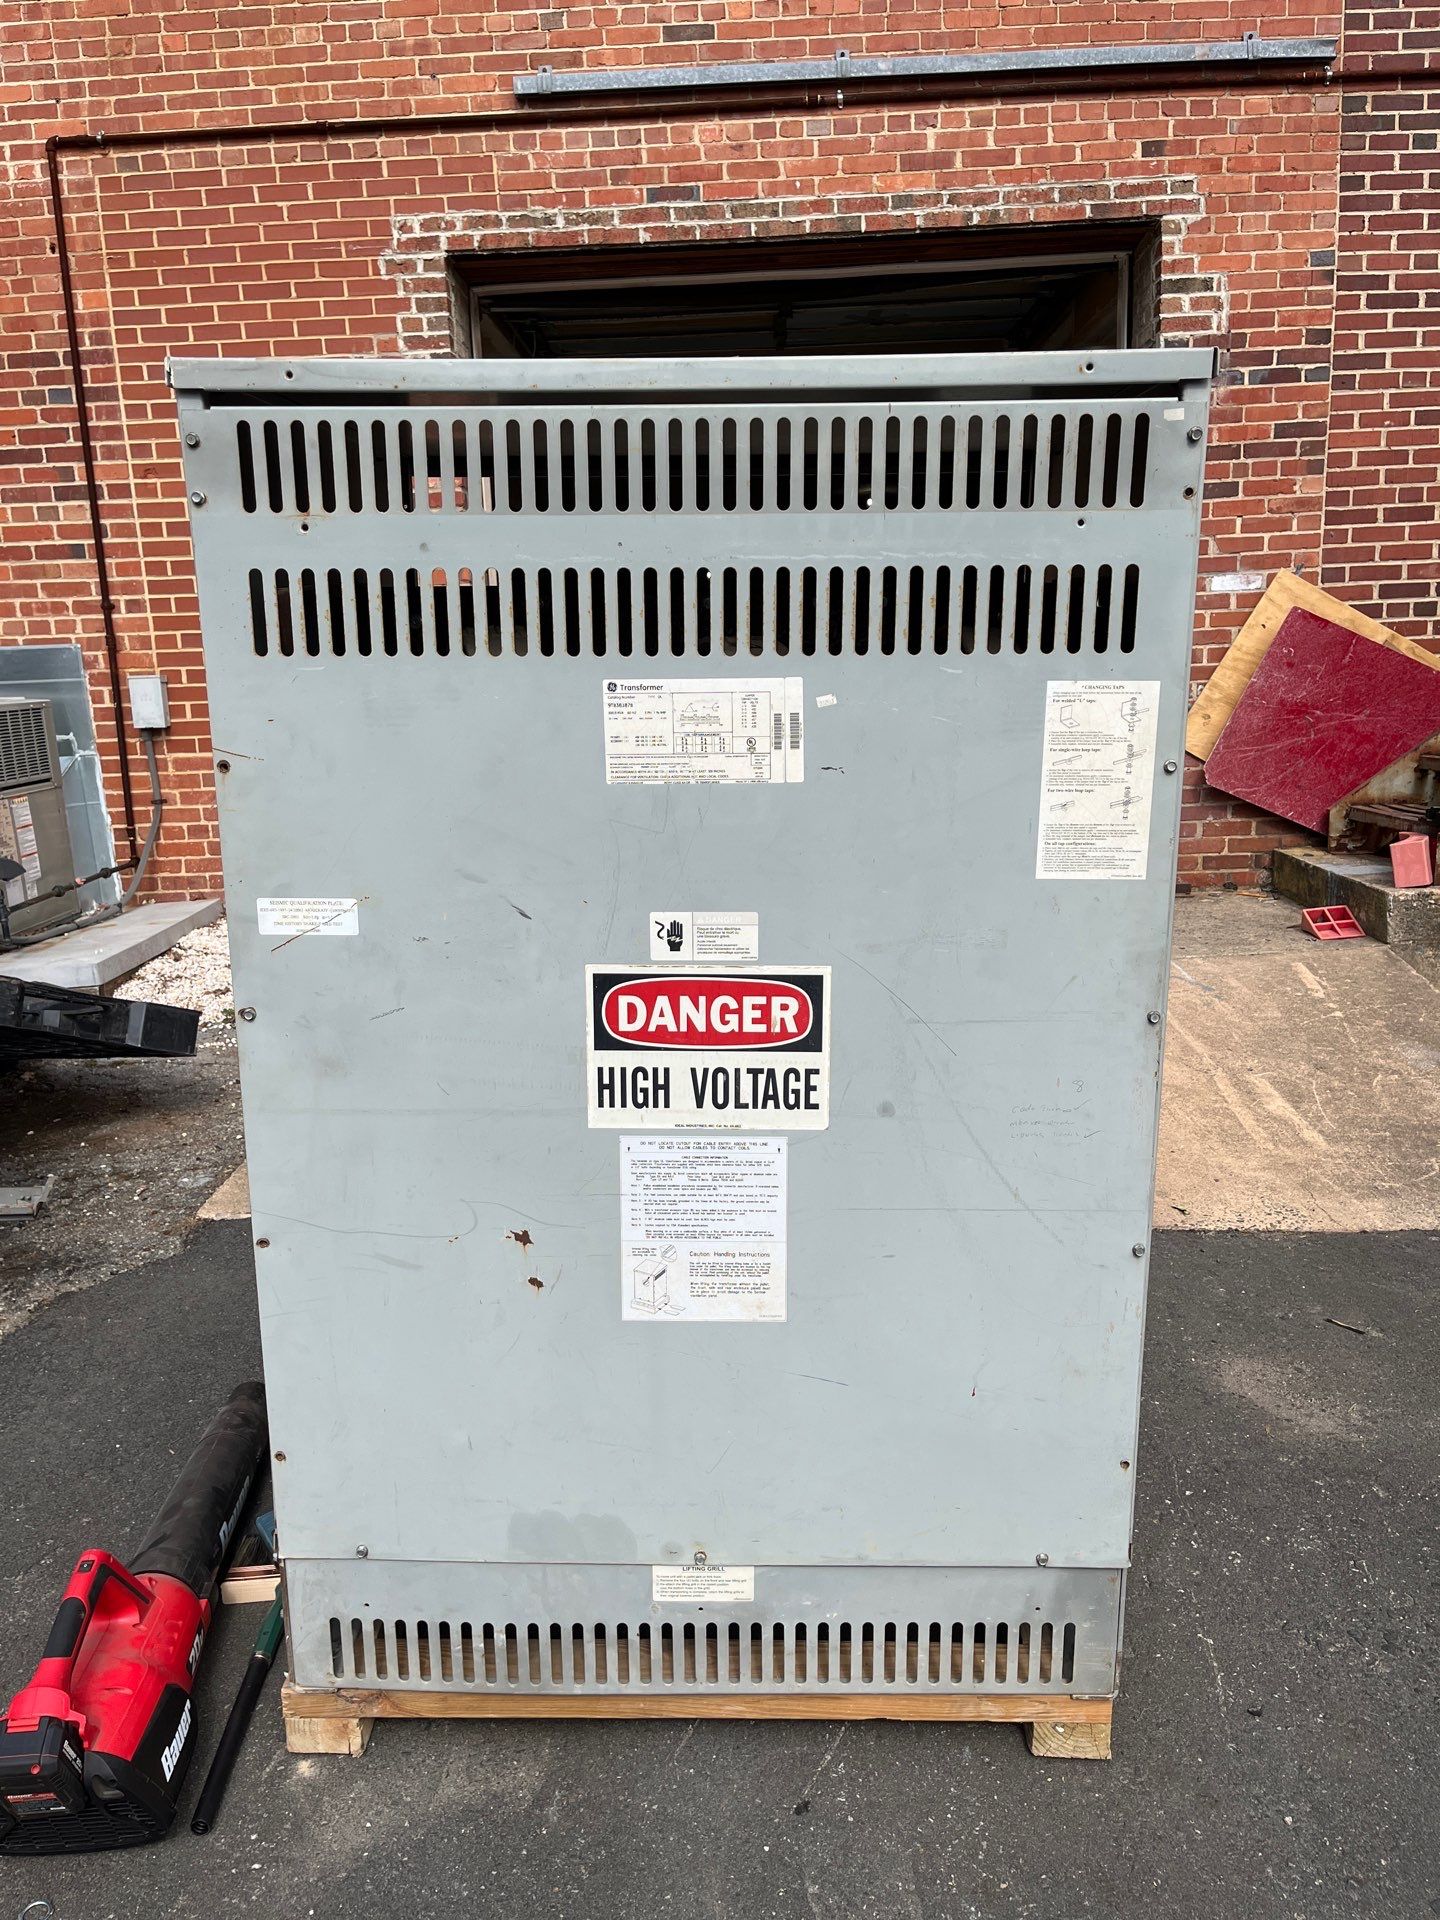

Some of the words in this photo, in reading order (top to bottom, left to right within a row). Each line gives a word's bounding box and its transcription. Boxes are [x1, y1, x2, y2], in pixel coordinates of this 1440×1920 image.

[617, 995, 800, 1034] DANGER
[597, 1066, 671, 1109] HIGH
[690, 1066, 820, 1110] VOLTAGE
[160, 1699, 191, 1782] Bauer
